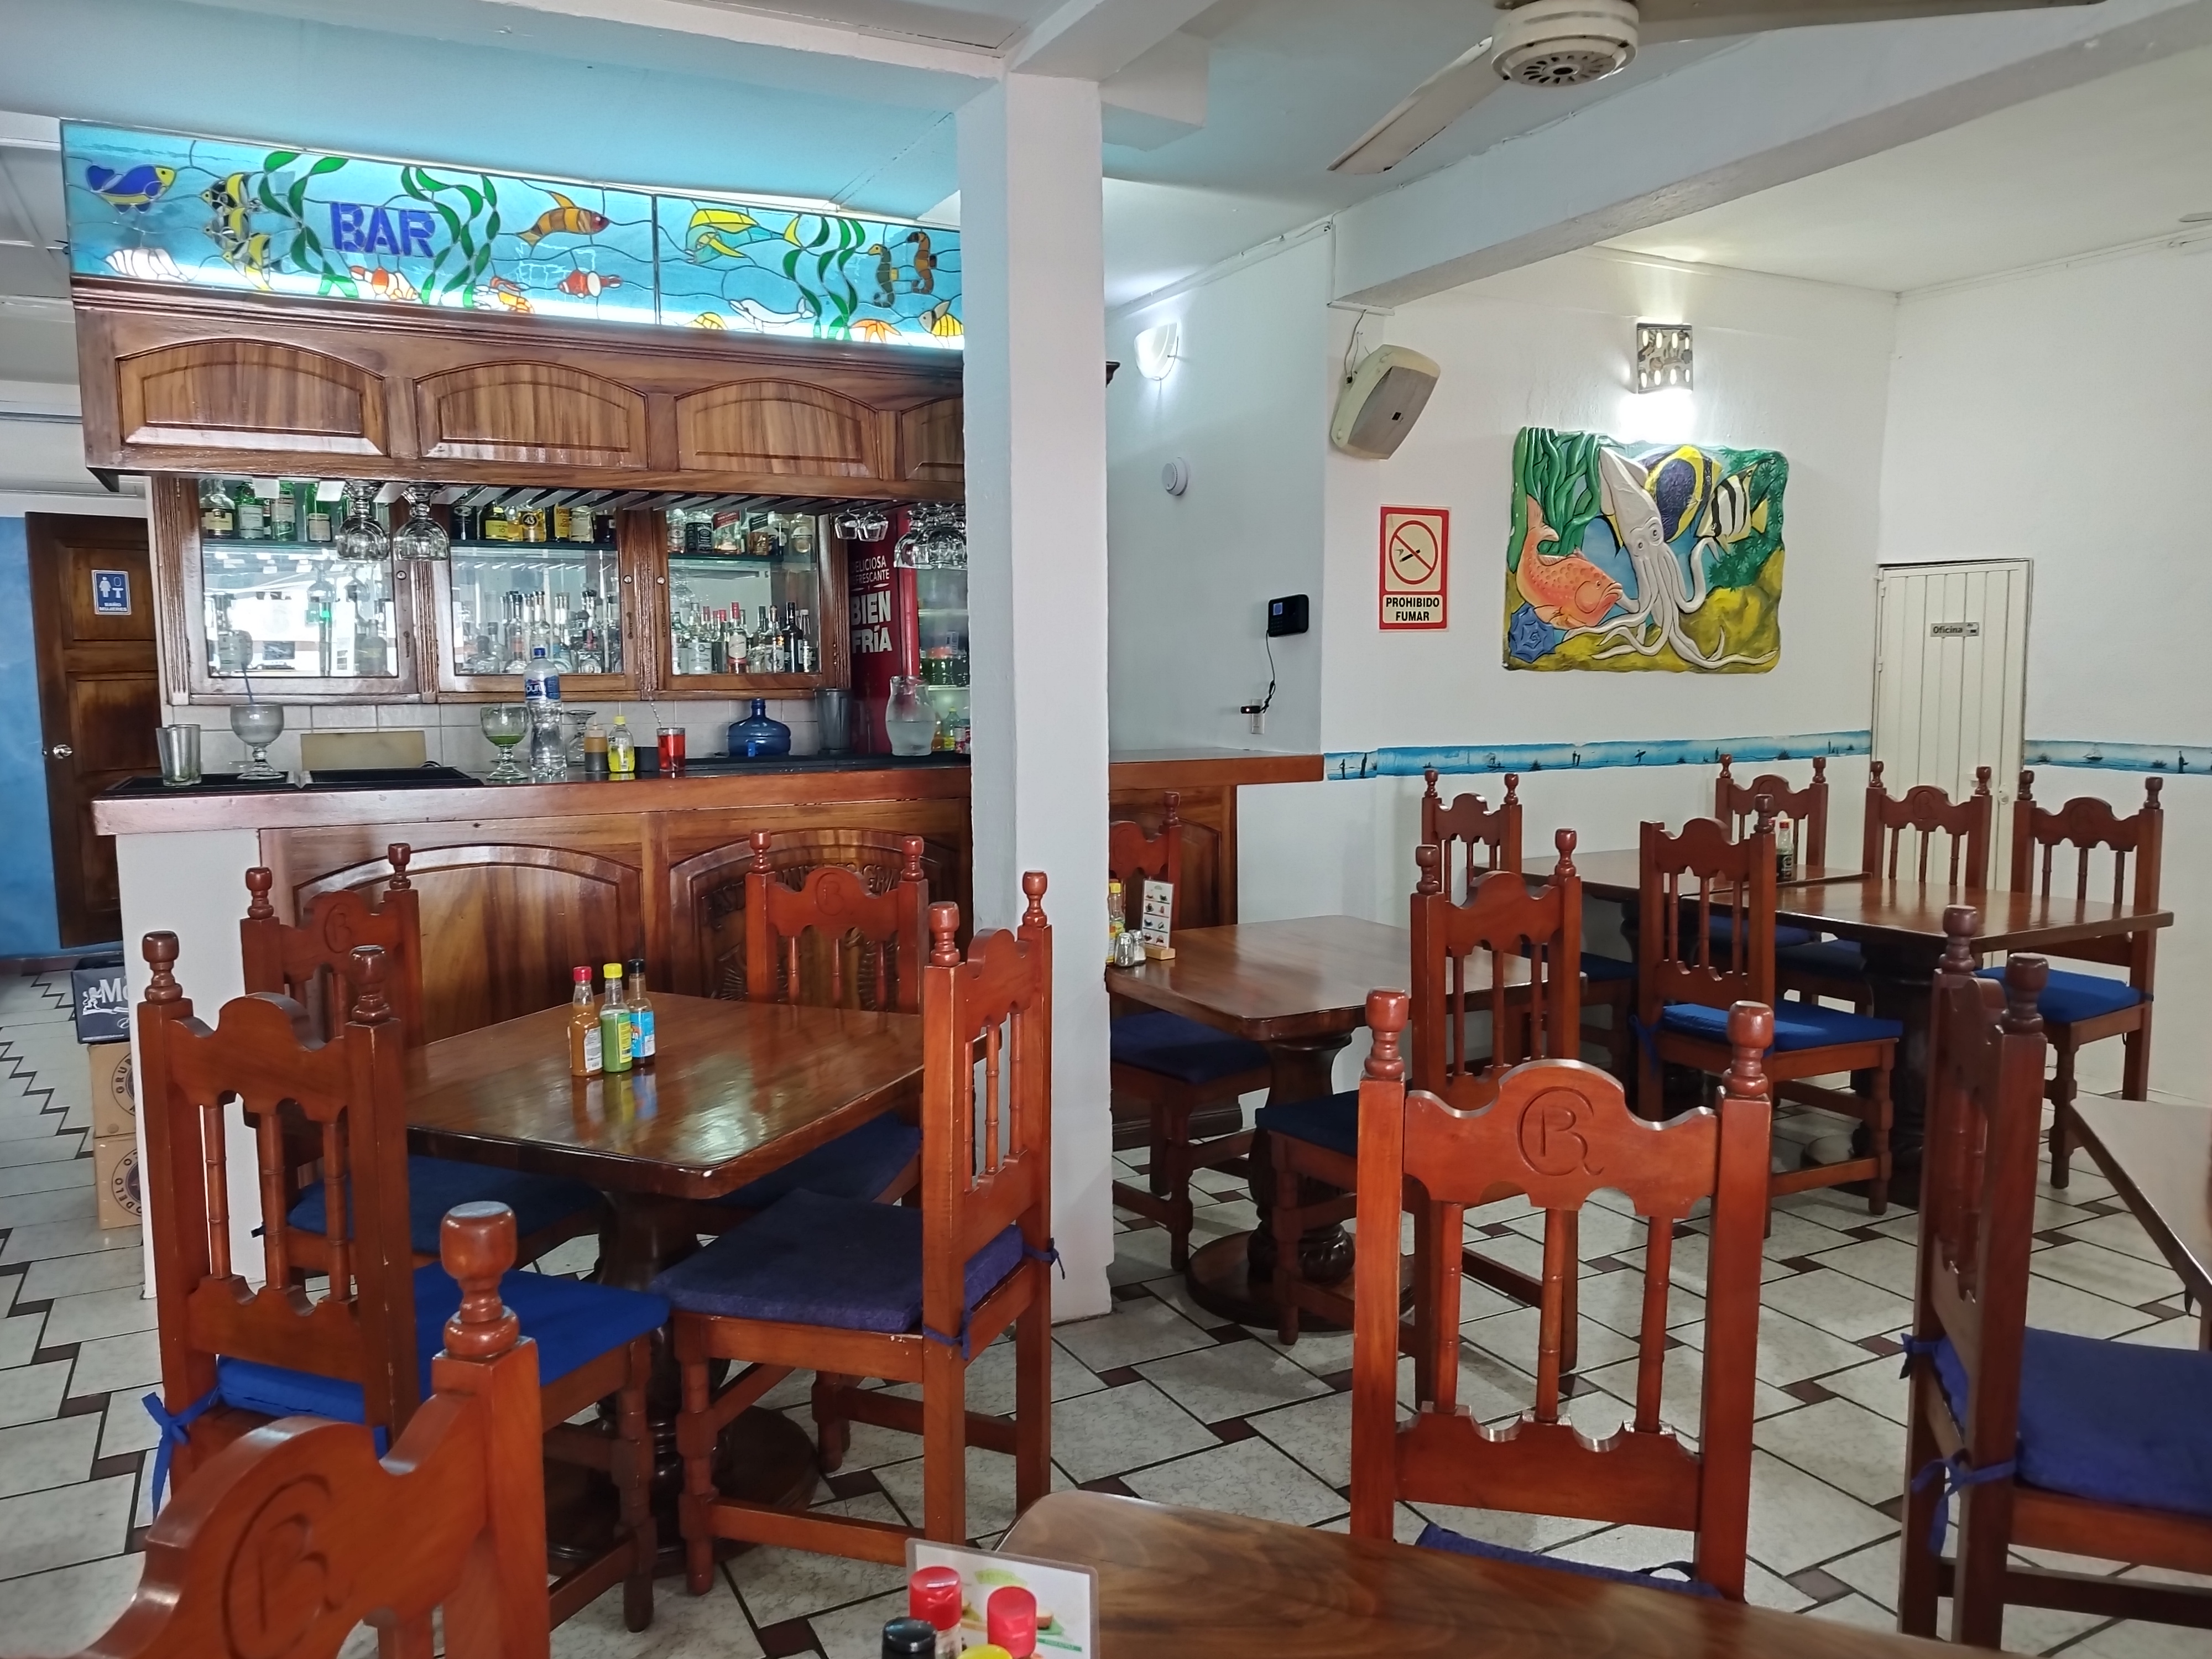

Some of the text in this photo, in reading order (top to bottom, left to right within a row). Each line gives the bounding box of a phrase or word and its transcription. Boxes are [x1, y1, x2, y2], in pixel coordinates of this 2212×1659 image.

[331, 202, 435, 258] BAR
[524, 517, 535, 525] 43
[1386, 597, 1439, 607] PROHIBIDO
[851, 591, 891, 625] BIEN
[1396, 611, 1430, 621] FUMAR
[1933, 625, 1963, 634] Oficina
